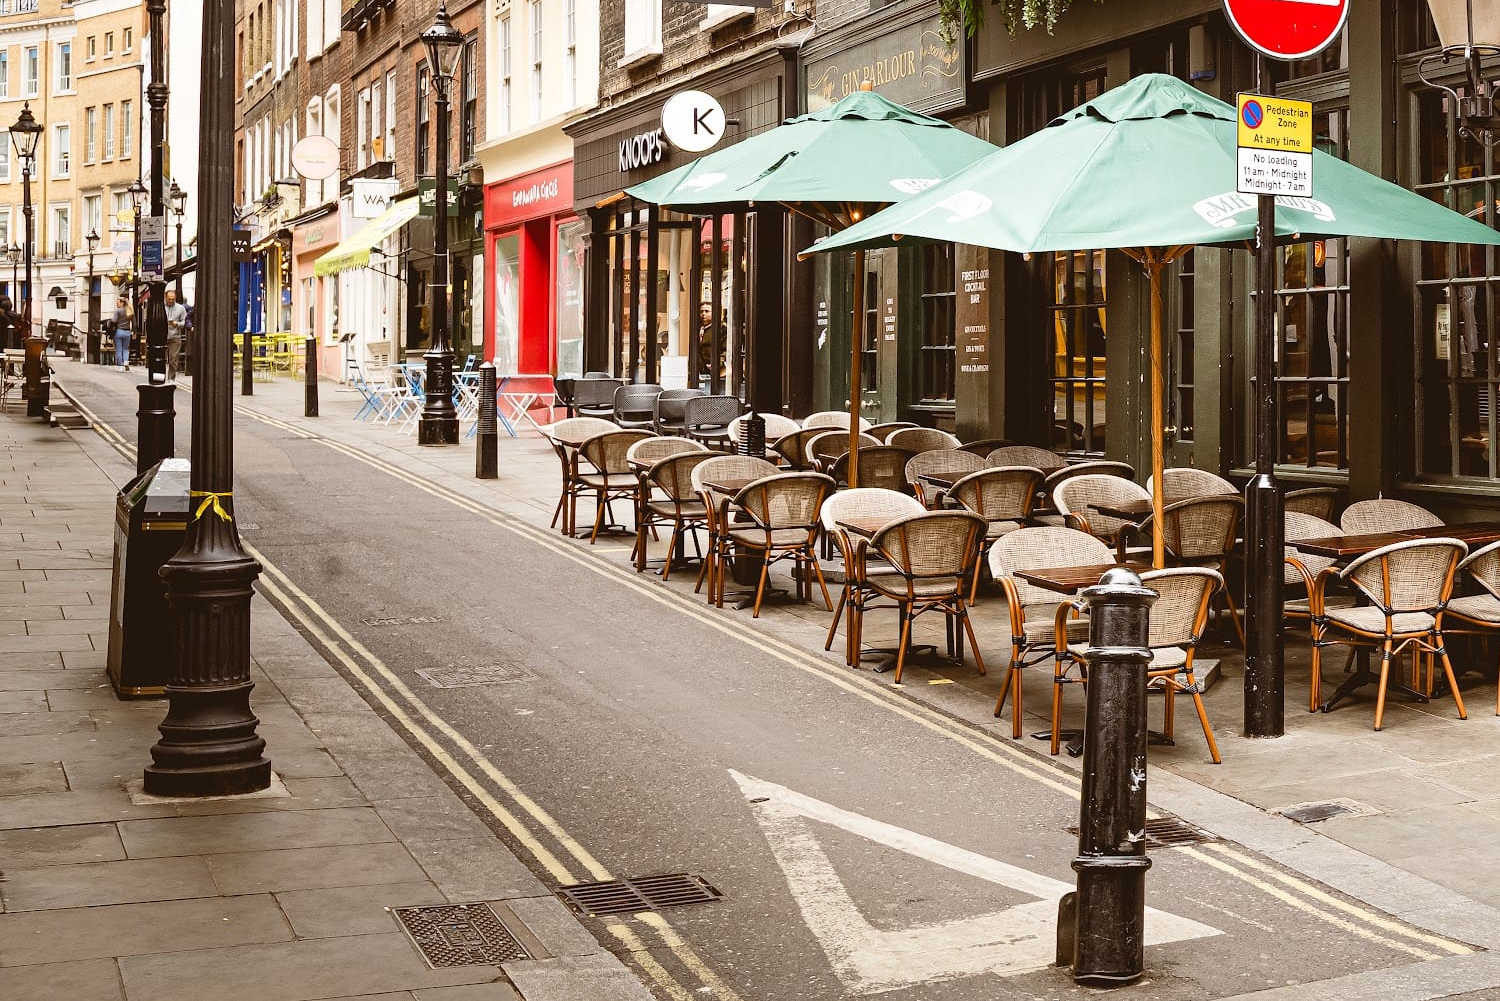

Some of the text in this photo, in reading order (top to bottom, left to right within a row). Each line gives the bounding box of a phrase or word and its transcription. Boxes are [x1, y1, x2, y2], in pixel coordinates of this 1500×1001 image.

[841, 68, 860, 97] GIN
[864, 50, 916, 89] PARLOUR
[1266, 104, 1309, 118] Pedestrian
[693, 107, 715, 135] K
[1278, 118, 1297, 129] Zone
[1254, 134, 1301, 147] At any time
[620, 127, 662, 173] KNOOPS
[1254, 153, 1298, 167] No loading
[1272, 168, 1307, 180] Midnight
[1245, 178, 1281, 190] Midnight
[1288, 181, 1306, 192] 7am
[363, 194, 386, 206] WA
[1207, 193, 1251, 218] MR
[962, 269, 989, 281] FIRST FLOOR
